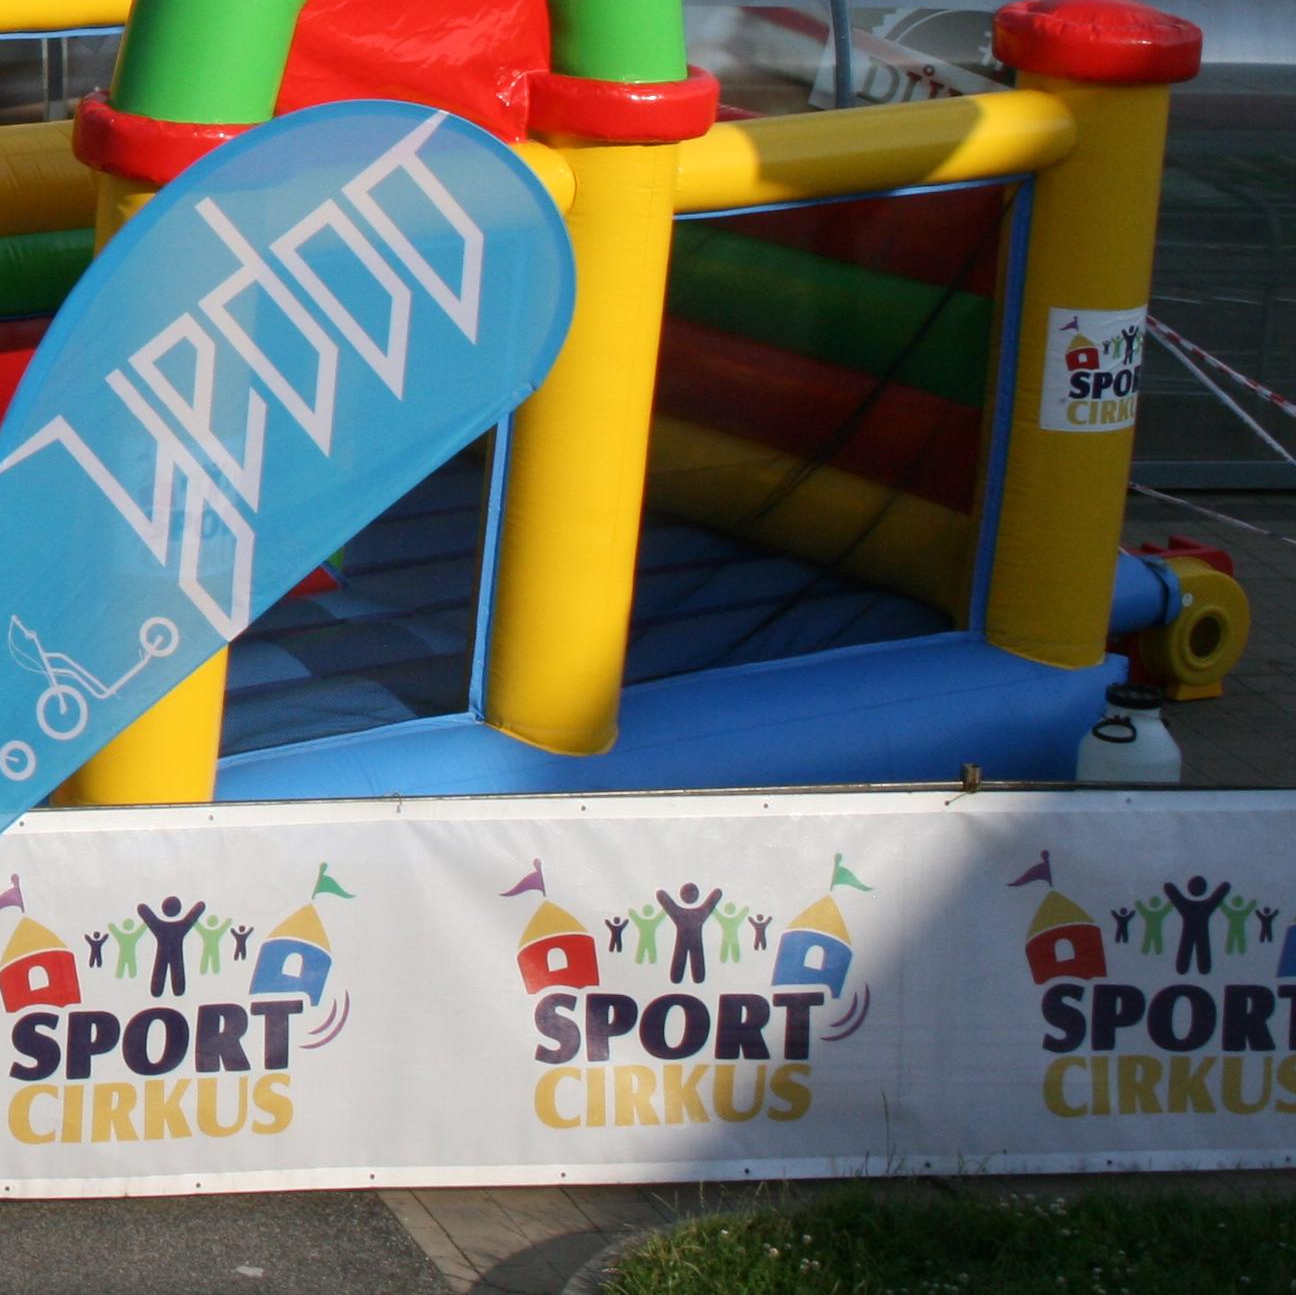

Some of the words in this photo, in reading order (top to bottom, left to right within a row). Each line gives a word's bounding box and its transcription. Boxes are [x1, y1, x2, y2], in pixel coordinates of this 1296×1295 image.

[10, 999, 304, 1081] SPORT
[534, 991, 824, 1064] SPORT
[7, 1073, 294, 1145] CIRKUS
[534, 1063, 812, 1130] CIRKUS
